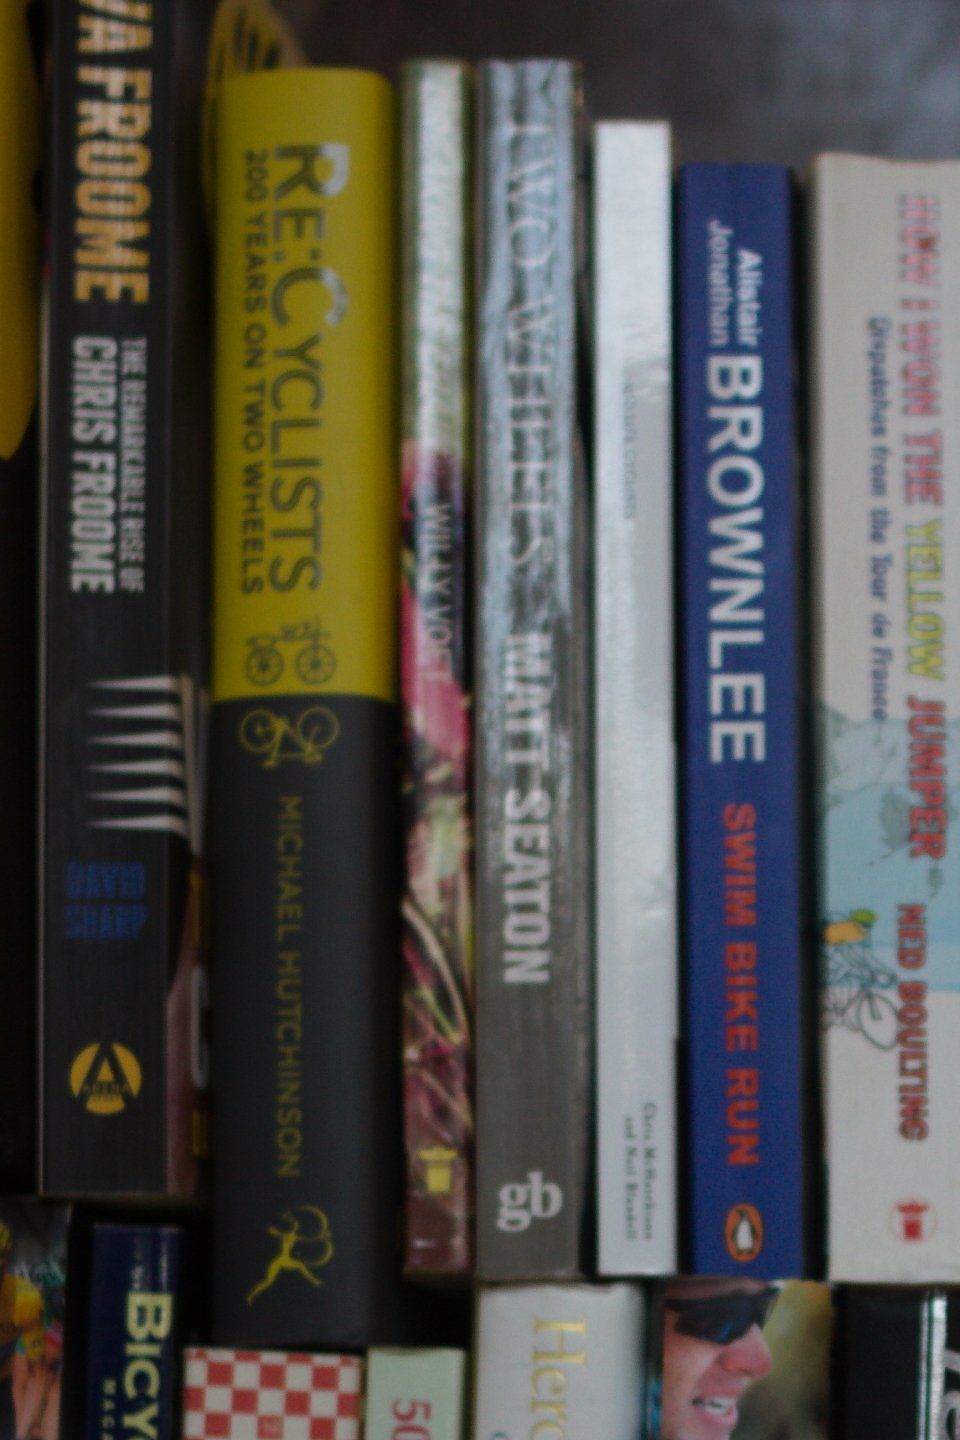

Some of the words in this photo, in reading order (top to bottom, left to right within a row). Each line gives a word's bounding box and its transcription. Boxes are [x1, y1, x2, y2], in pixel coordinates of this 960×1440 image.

[75, 65, 153, 303] FROOME
[244, 150, 269, 200] 200
[242, 212, 267, 313] YEARS
[706, 218, 734, 345] Jonathan
[736, 249, 763, 346] Alistair
[70, 336, 118, 443] CHRIS
[121, 336, 147, 374] THE
[242, 321, 267, 367] ON
[865, 316, 893, 437] Dispatches
[900, 321, 944, 417] WON
[120, 380, 147, 511] REMARKABLE
[241, 376, 266, 454] TWO
[901, 427, 946, 506] THE
[69, 448, 117, 594] FROOME
[869, 447, 893, 496] from
[120, 517, 146, 555] RISE
[120, 564, 145, 593] OF
[240, 463, 266, 596] WHEELS
[707, 354, 767, 764] BROWNLEE
[870, 508, 893, 545] the
[870, 554, 893, 601] Tour
[870, 612, 893, 639] de
[904, 519, 947, 681] YELLOW
[502, 631, 554, 769] MATT
[870, 646, 894, 723] France
[907, 693, 949, 862] JUMPER
[277, 794, 301, 942] MICHAEL
[502, 788, 552, 985] SEATON
[721, 801, 759, 926] SWIM
[897, 903, 929, 970] NED
[721, 941, 759, 1051] BIKE
[276, 950, 301, 1178] HUTCHINSON
[897, 980, 930, 1142] BOULTING
[723, 1067, 758, 1166] RUN
